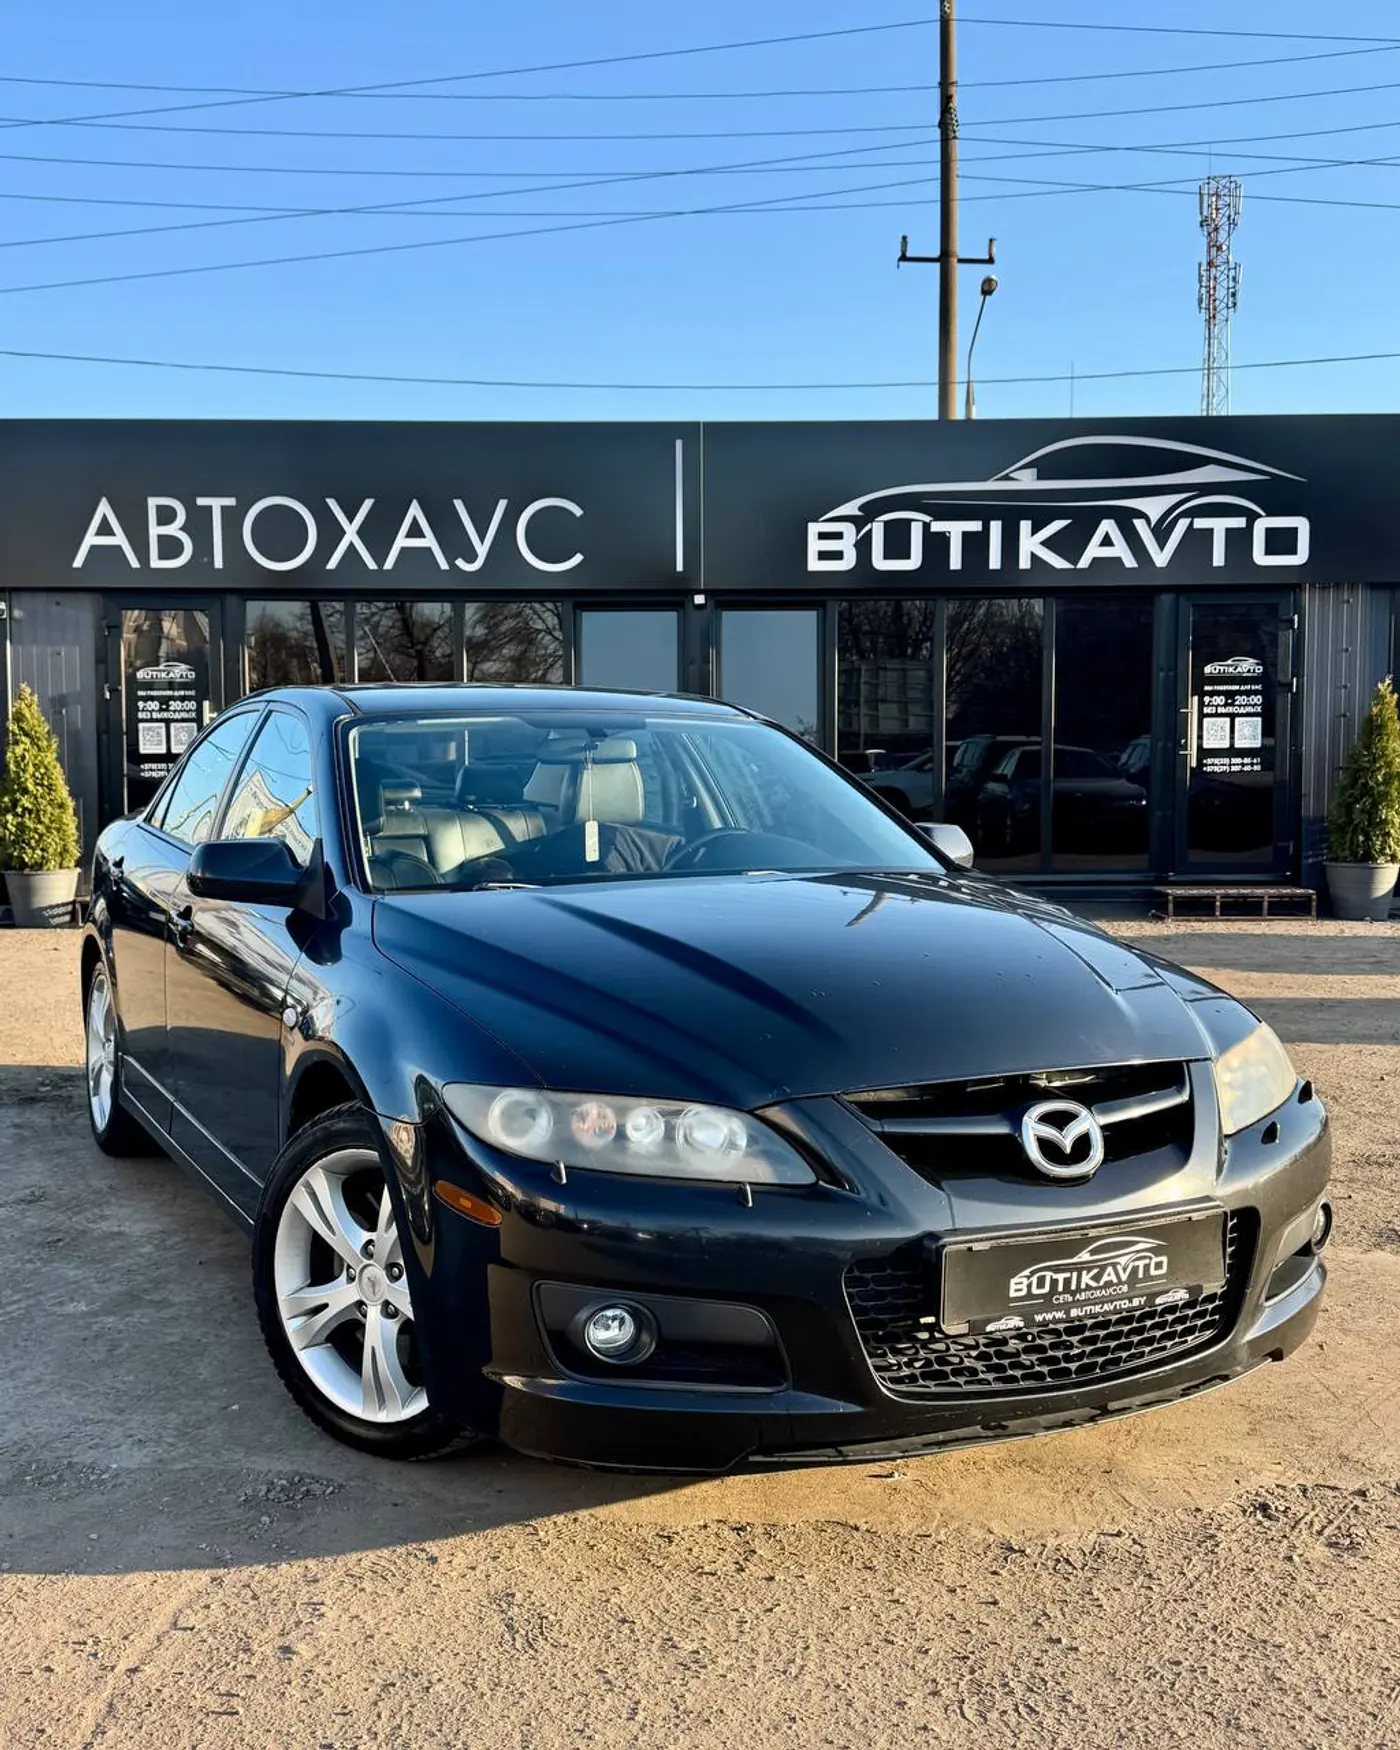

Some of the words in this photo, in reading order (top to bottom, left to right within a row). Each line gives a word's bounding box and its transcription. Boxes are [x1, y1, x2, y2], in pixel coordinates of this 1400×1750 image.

[72, 496, 586, 573] АВТОХАУС
[806, 515, 1311, 572] BUTIKAVTO
[136, 670, 195, 679] BUTIKAVTO
[1204, 665, 1263, 674] BUTIKAVTO
[137, 700, 160, 711] 9:00
[168, 700, 197, 711] 20:00
[1203, 695, 1225, 706] 9:00
[1234, 694, 1263, 705] 20:00
[138, 711, 151, 719] БЕЗ
[152, 711, 197, 719] ВЫХОДНЫХ
[1203, 706, 1216, 714] БЕЗ
[1217, 706, 1263, 714] ВЫХОДНЫХ
[1008, 1256, 1168, 1298] BUTIKAVTO
[1052, 1293, 1073, 1304] СЕТЬ
[1075, 1284, 1128, 1301] АВТОХАУСОВ
[1034, 1309, 1066, 1322] WWW.
[1070, 1296, 1147, 1317] BUTIKAVTO.BY
